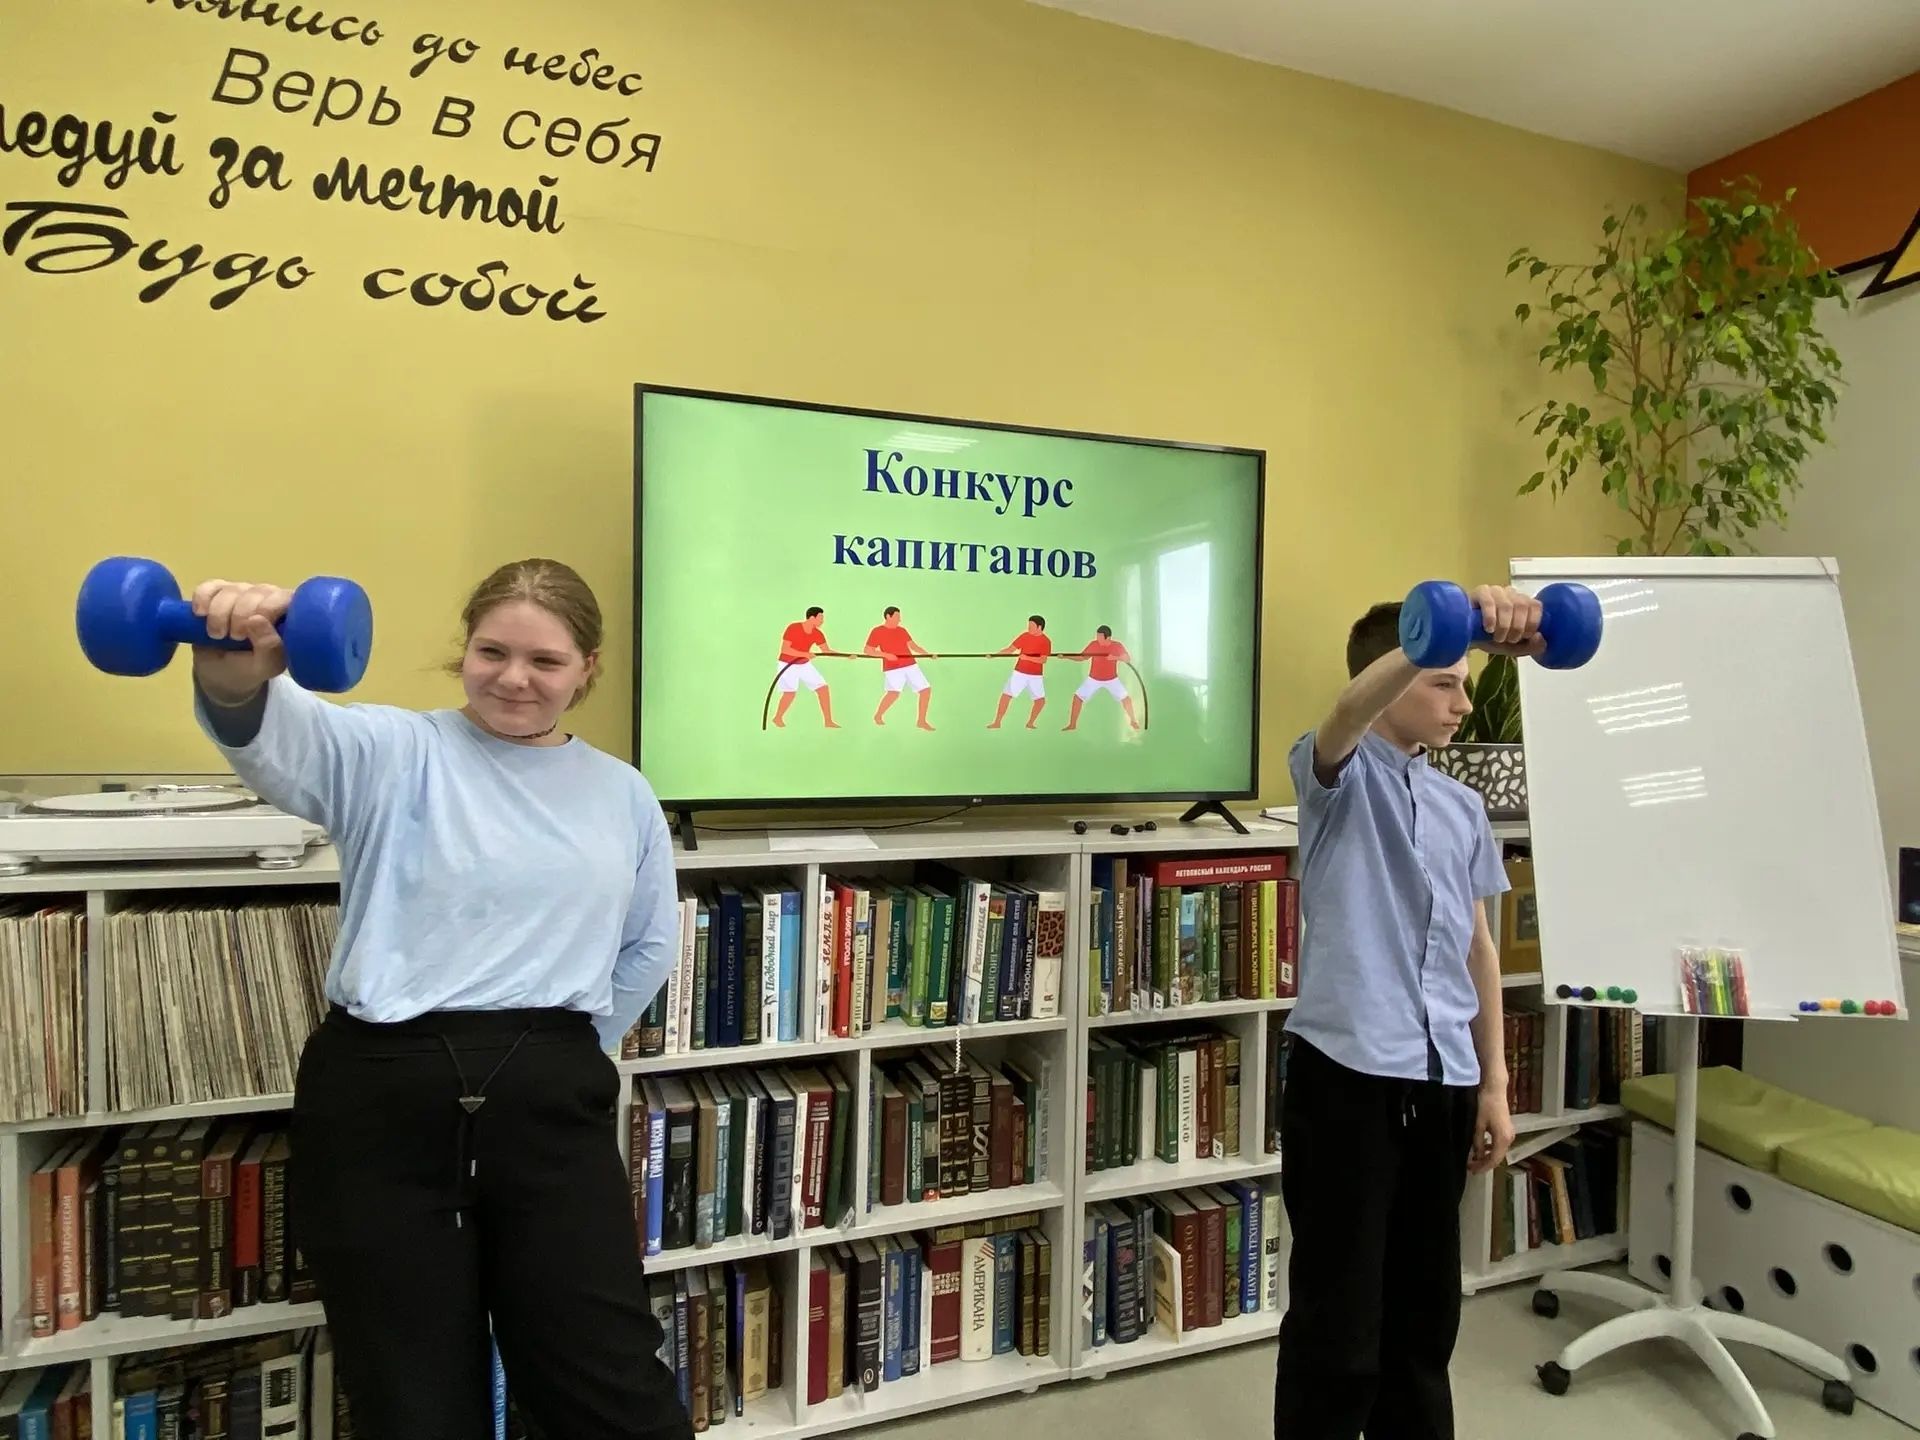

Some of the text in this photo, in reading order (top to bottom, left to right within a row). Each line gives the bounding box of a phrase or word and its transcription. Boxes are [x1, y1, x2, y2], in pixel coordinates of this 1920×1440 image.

[410, 33, 480, 78] до
[503, 49, 644, 96] небес
[210, 48, 663, 173] Верь в себя
[0, 104, 565, 234] едуй за мечтой
[3, 201, 607, 324] Будь собой
[862, 449, 1074, 517] Конкурс
[832, 532, 1097, 579] капитанов
[764, 911, 778, 991] Подводный мир
[892, 920, 900, 975] МАТЕМАТИКА
[972, 906, 986, 974] Растения
[1023, 938, 1034, 1000] КОСМОНАВТИКА
[683, 945, 692, 1001] НАСЕКОМЫЕ
[1250, 1202, 1258, 1249] ТЕХНИКА
[973, 1256, 985, 1331] АМЕРИКАНА
[1248, 1263, 1256, 1296] НАУКА
